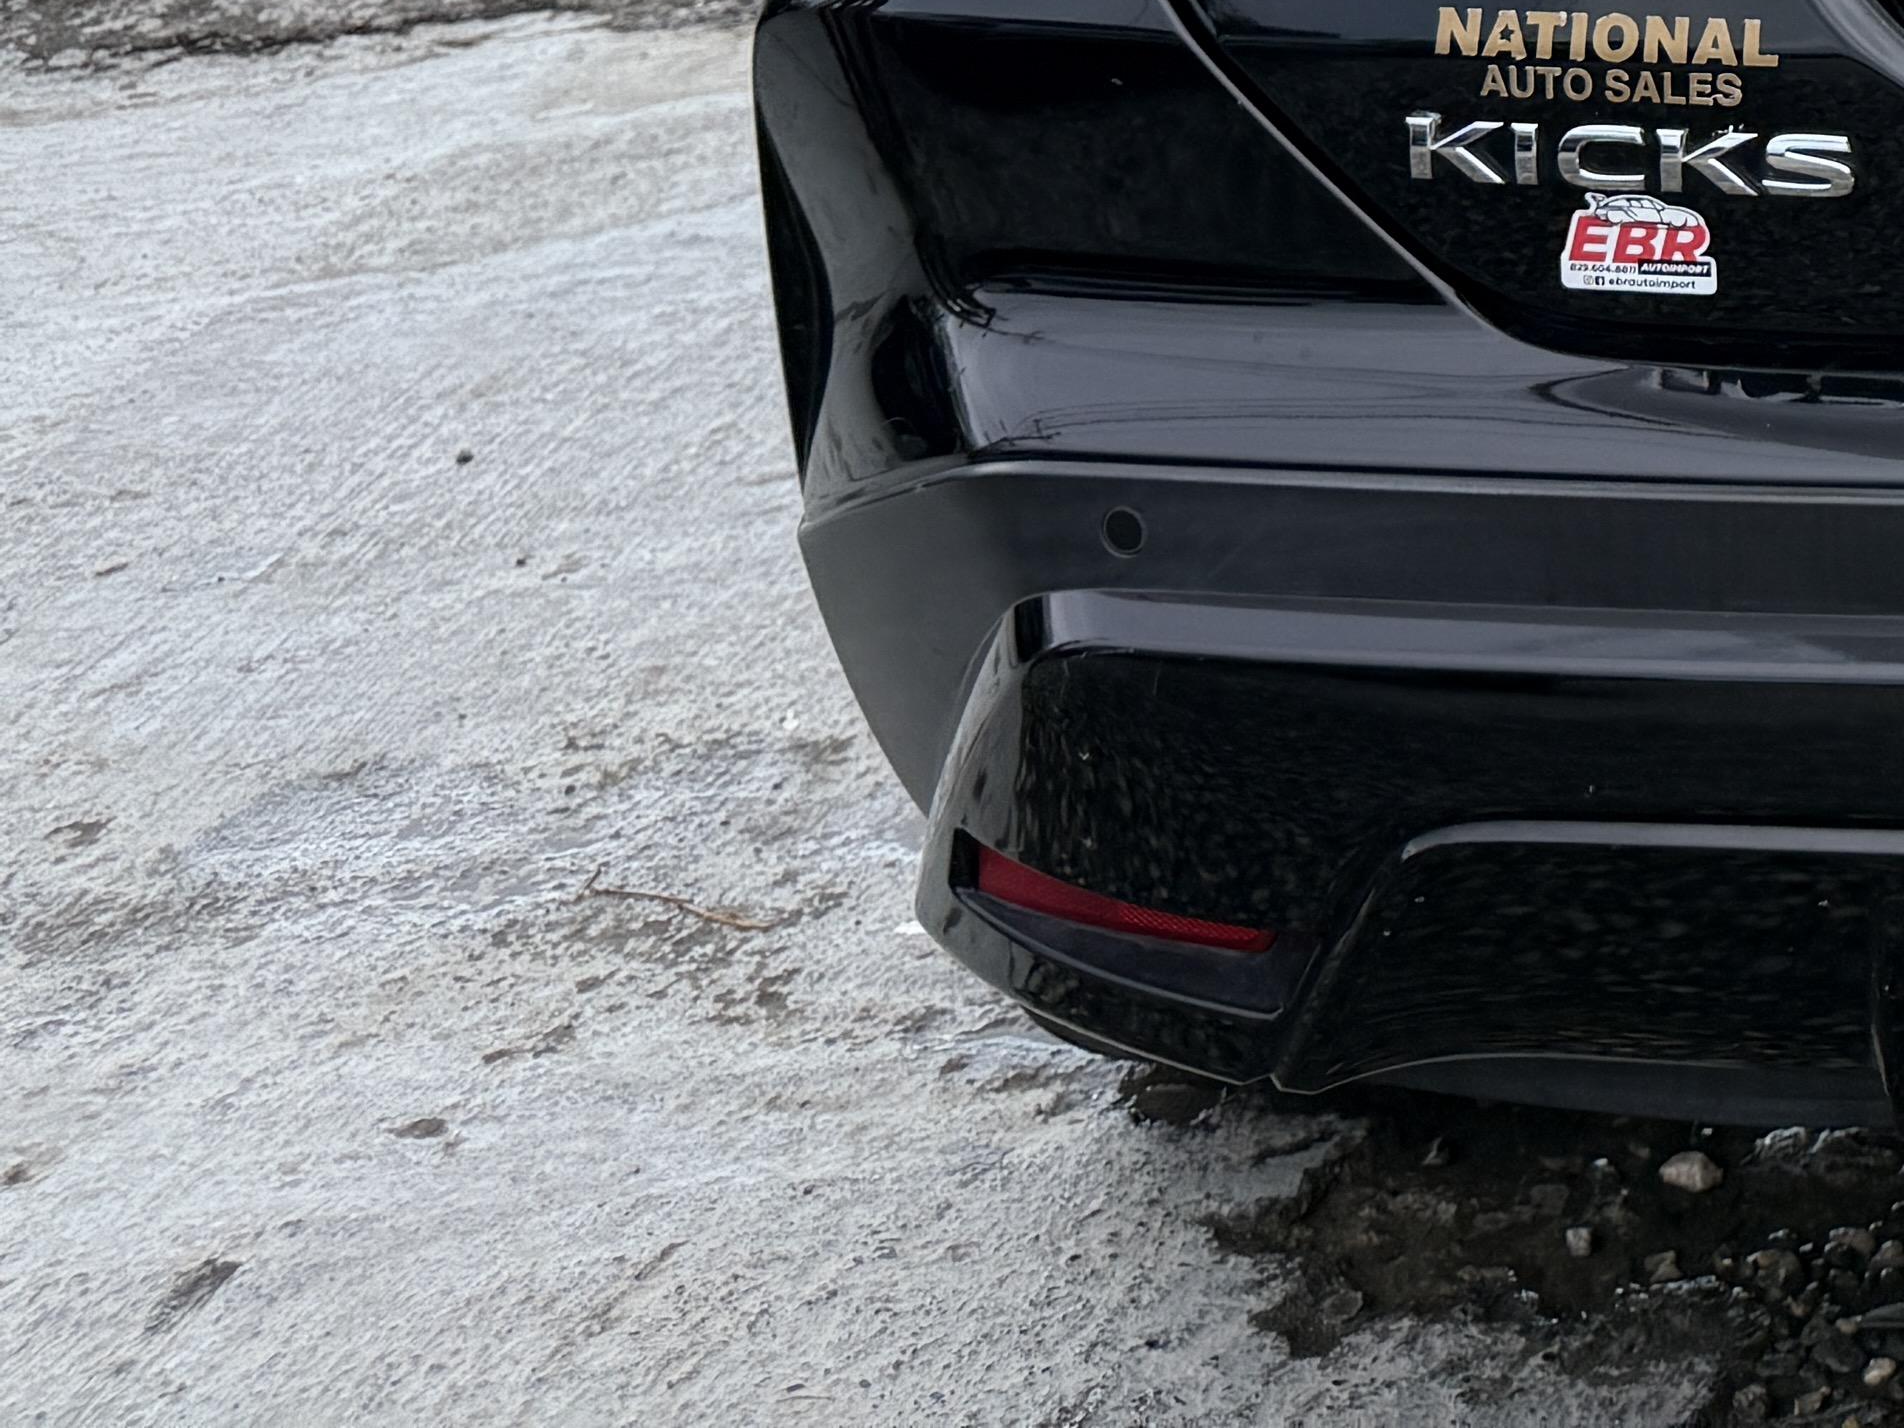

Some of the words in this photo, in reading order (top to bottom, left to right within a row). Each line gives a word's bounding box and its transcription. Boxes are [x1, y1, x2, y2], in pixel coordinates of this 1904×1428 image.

[1434, 6, 1780, 68] NATIONAL
[1480, 64, 1594, 102] AUTO
[1604, 68, 1744, 108] SALES
[1404, 114, 1856, 198] KICKS
[1568, 215, 1707, 264] EBR
[1608, 275, 1697, 290] ebrautoimport
[1639, 262, 1710, 275] AUTOIMPORT
